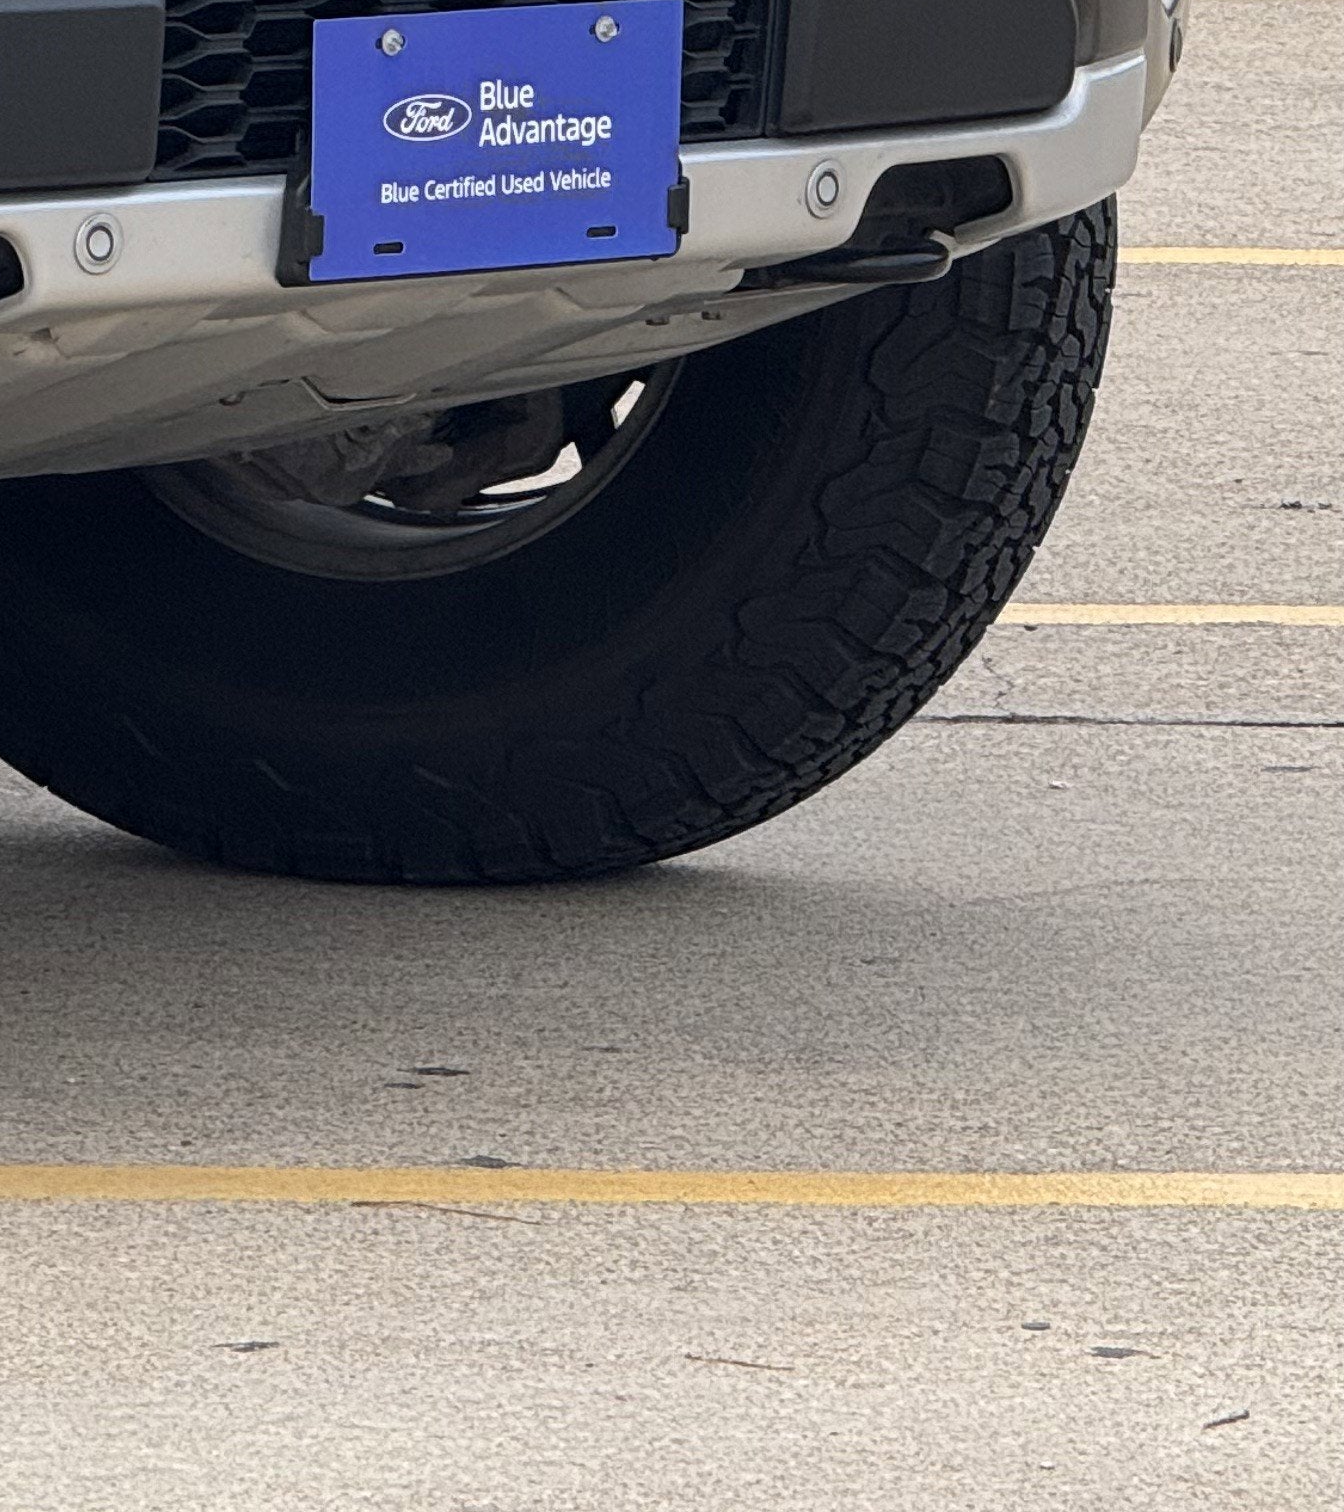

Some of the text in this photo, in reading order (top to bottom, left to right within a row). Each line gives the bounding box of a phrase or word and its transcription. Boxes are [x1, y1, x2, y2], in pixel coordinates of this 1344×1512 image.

[479, 80, 534, 111] Blue
[479, 113, 612, 147] Advantage
[381, 166, 612, 204] Blue Certified Used Vehicle
